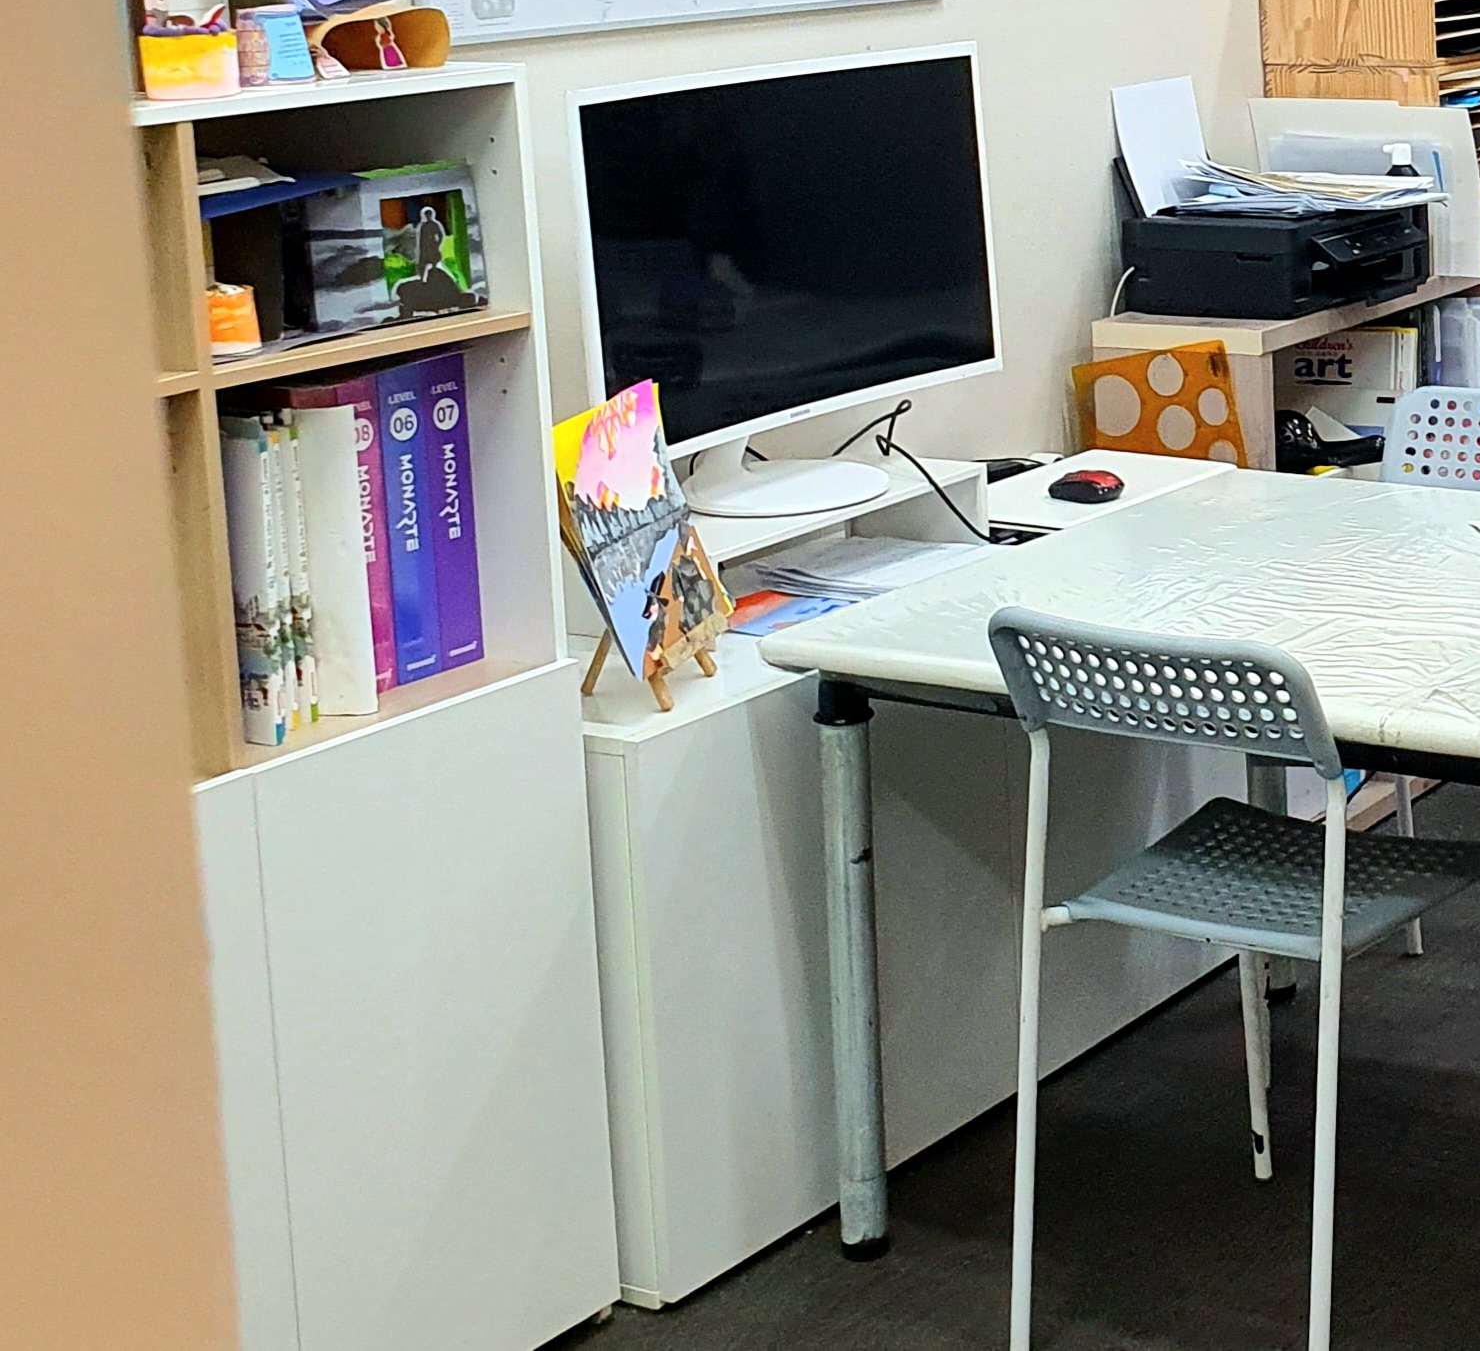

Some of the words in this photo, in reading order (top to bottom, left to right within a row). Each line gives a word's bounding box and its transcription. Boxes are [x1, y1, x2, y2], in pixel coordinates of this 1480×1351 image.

[1294, 354, 1352, 379] art
[388, 391, 416, 405] LEVEL
[431, 381, 458, 395] LEVEL
[393, 414, 414, 434] 06
[436, 405, 455, 424] 07
[439, 443, 462, 540] MONARTE
[396, 453, 420, 552] MONARTE
